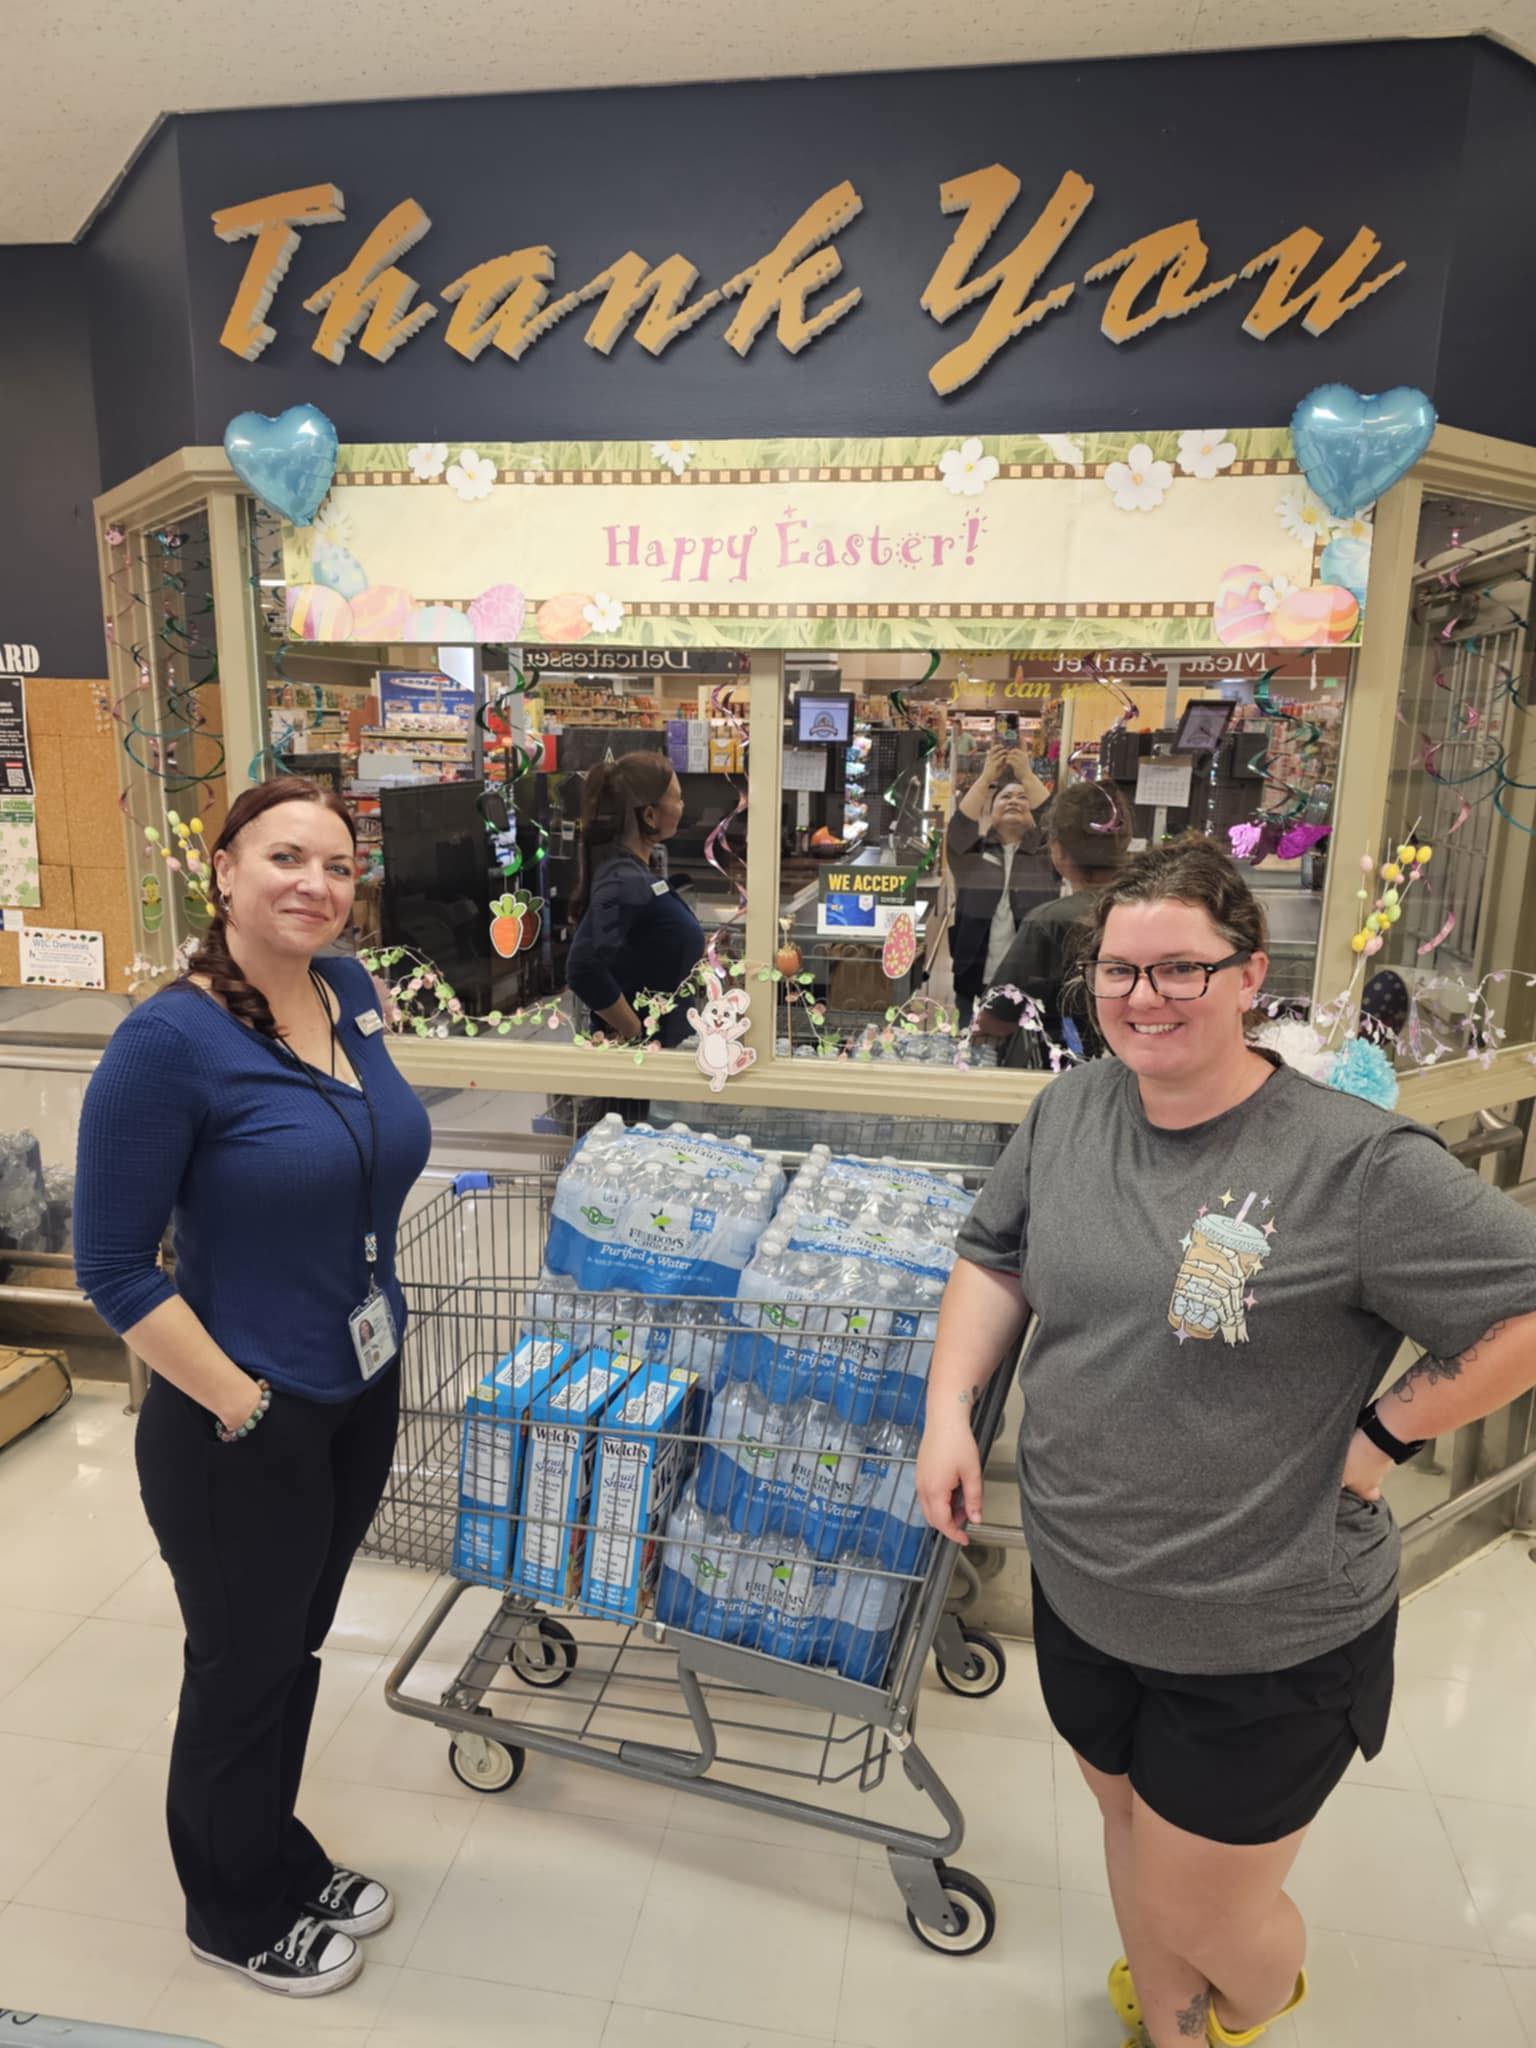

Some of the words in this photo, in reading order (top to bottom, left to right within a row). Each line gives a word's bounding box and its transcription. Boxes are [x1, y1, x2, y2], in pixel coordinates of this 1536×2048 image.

[211, 179, 863, 366] Thank
[920, 163, 1407, 396] You
[602, 522, 758, 583] Happy
[775, 504, 989, 570] Easter!
[1003, 681, 1051, 698] can
[828, 873, 851, 891] WE
[853, 874, 908, 892] ACCEPT
[599, 1243, 646, 1263] Purified
[656, 1255, 693, 1271] Water
[895, 1316, 914, 1334] 24
